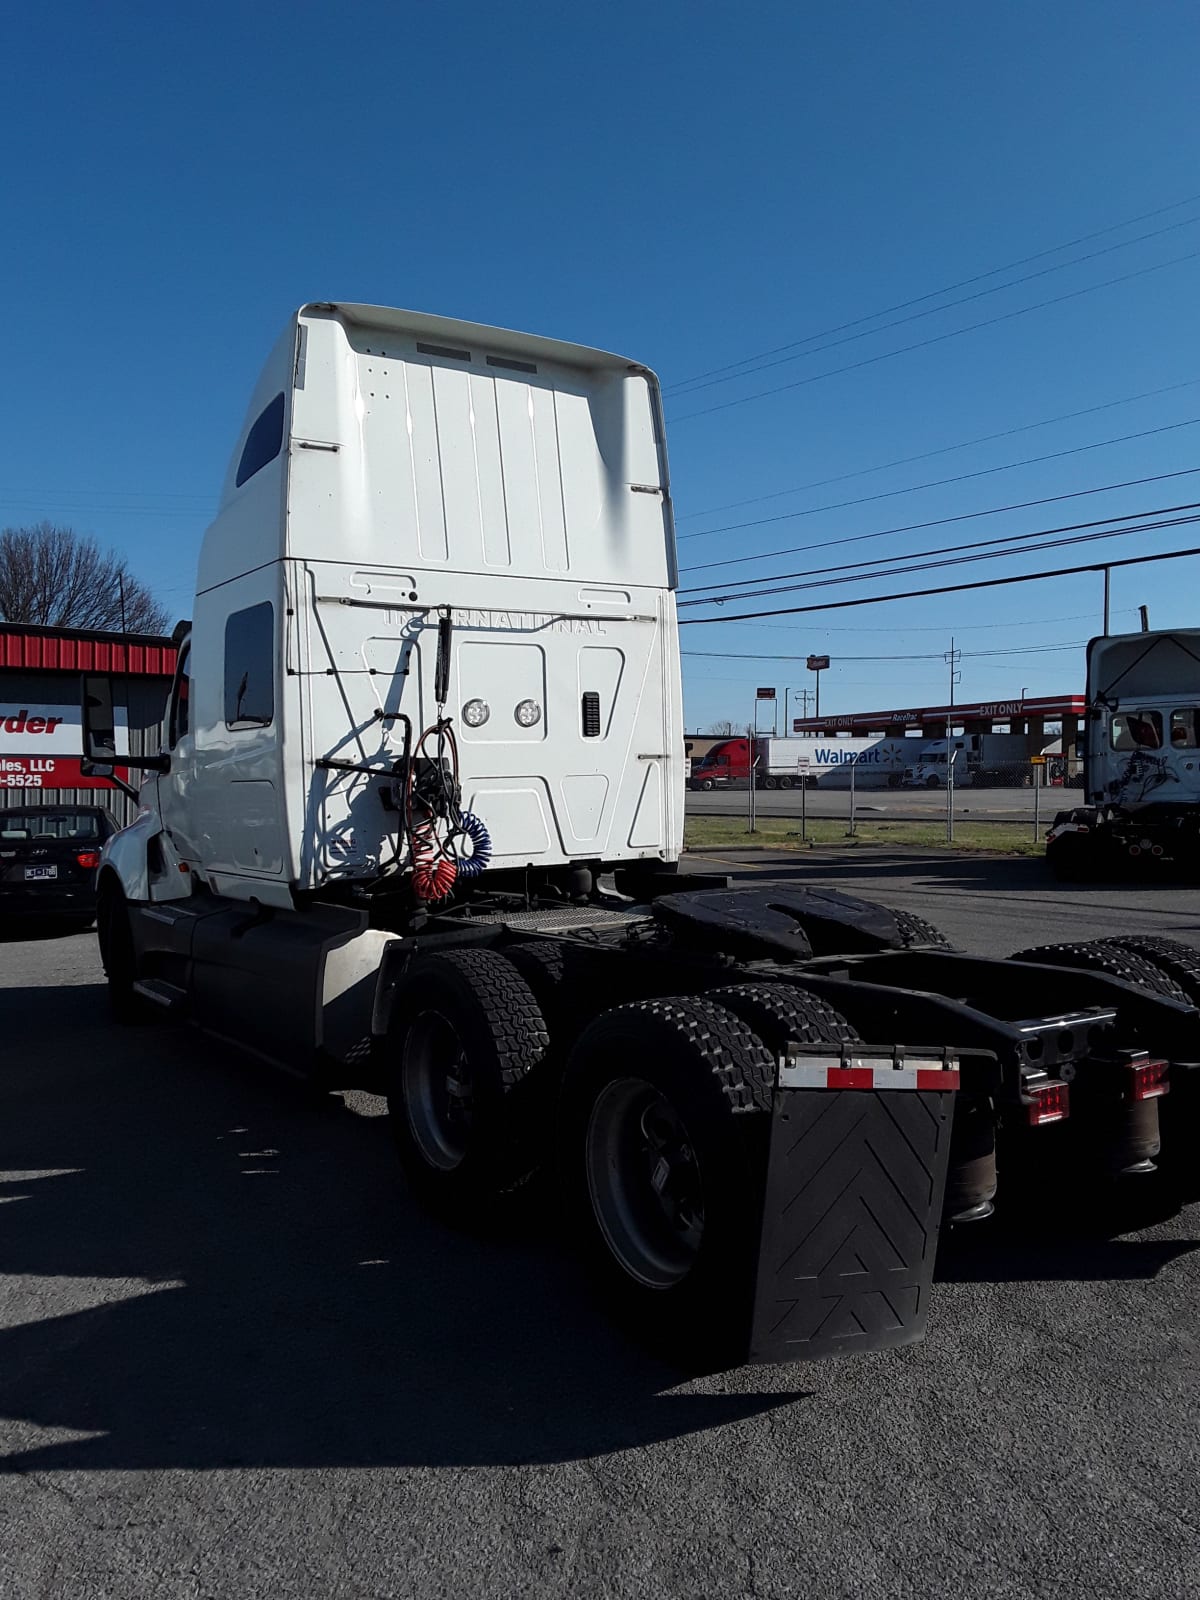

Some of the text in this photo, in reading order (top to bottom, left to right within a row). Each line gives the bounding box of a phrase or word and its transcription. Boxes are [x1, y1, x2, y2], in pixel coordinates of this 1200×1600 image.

[979, 703, 1023, 716] EXIT ONLY
[815, 748, 880, 764] Walmart
[30, 759, 55, 772] LLC
